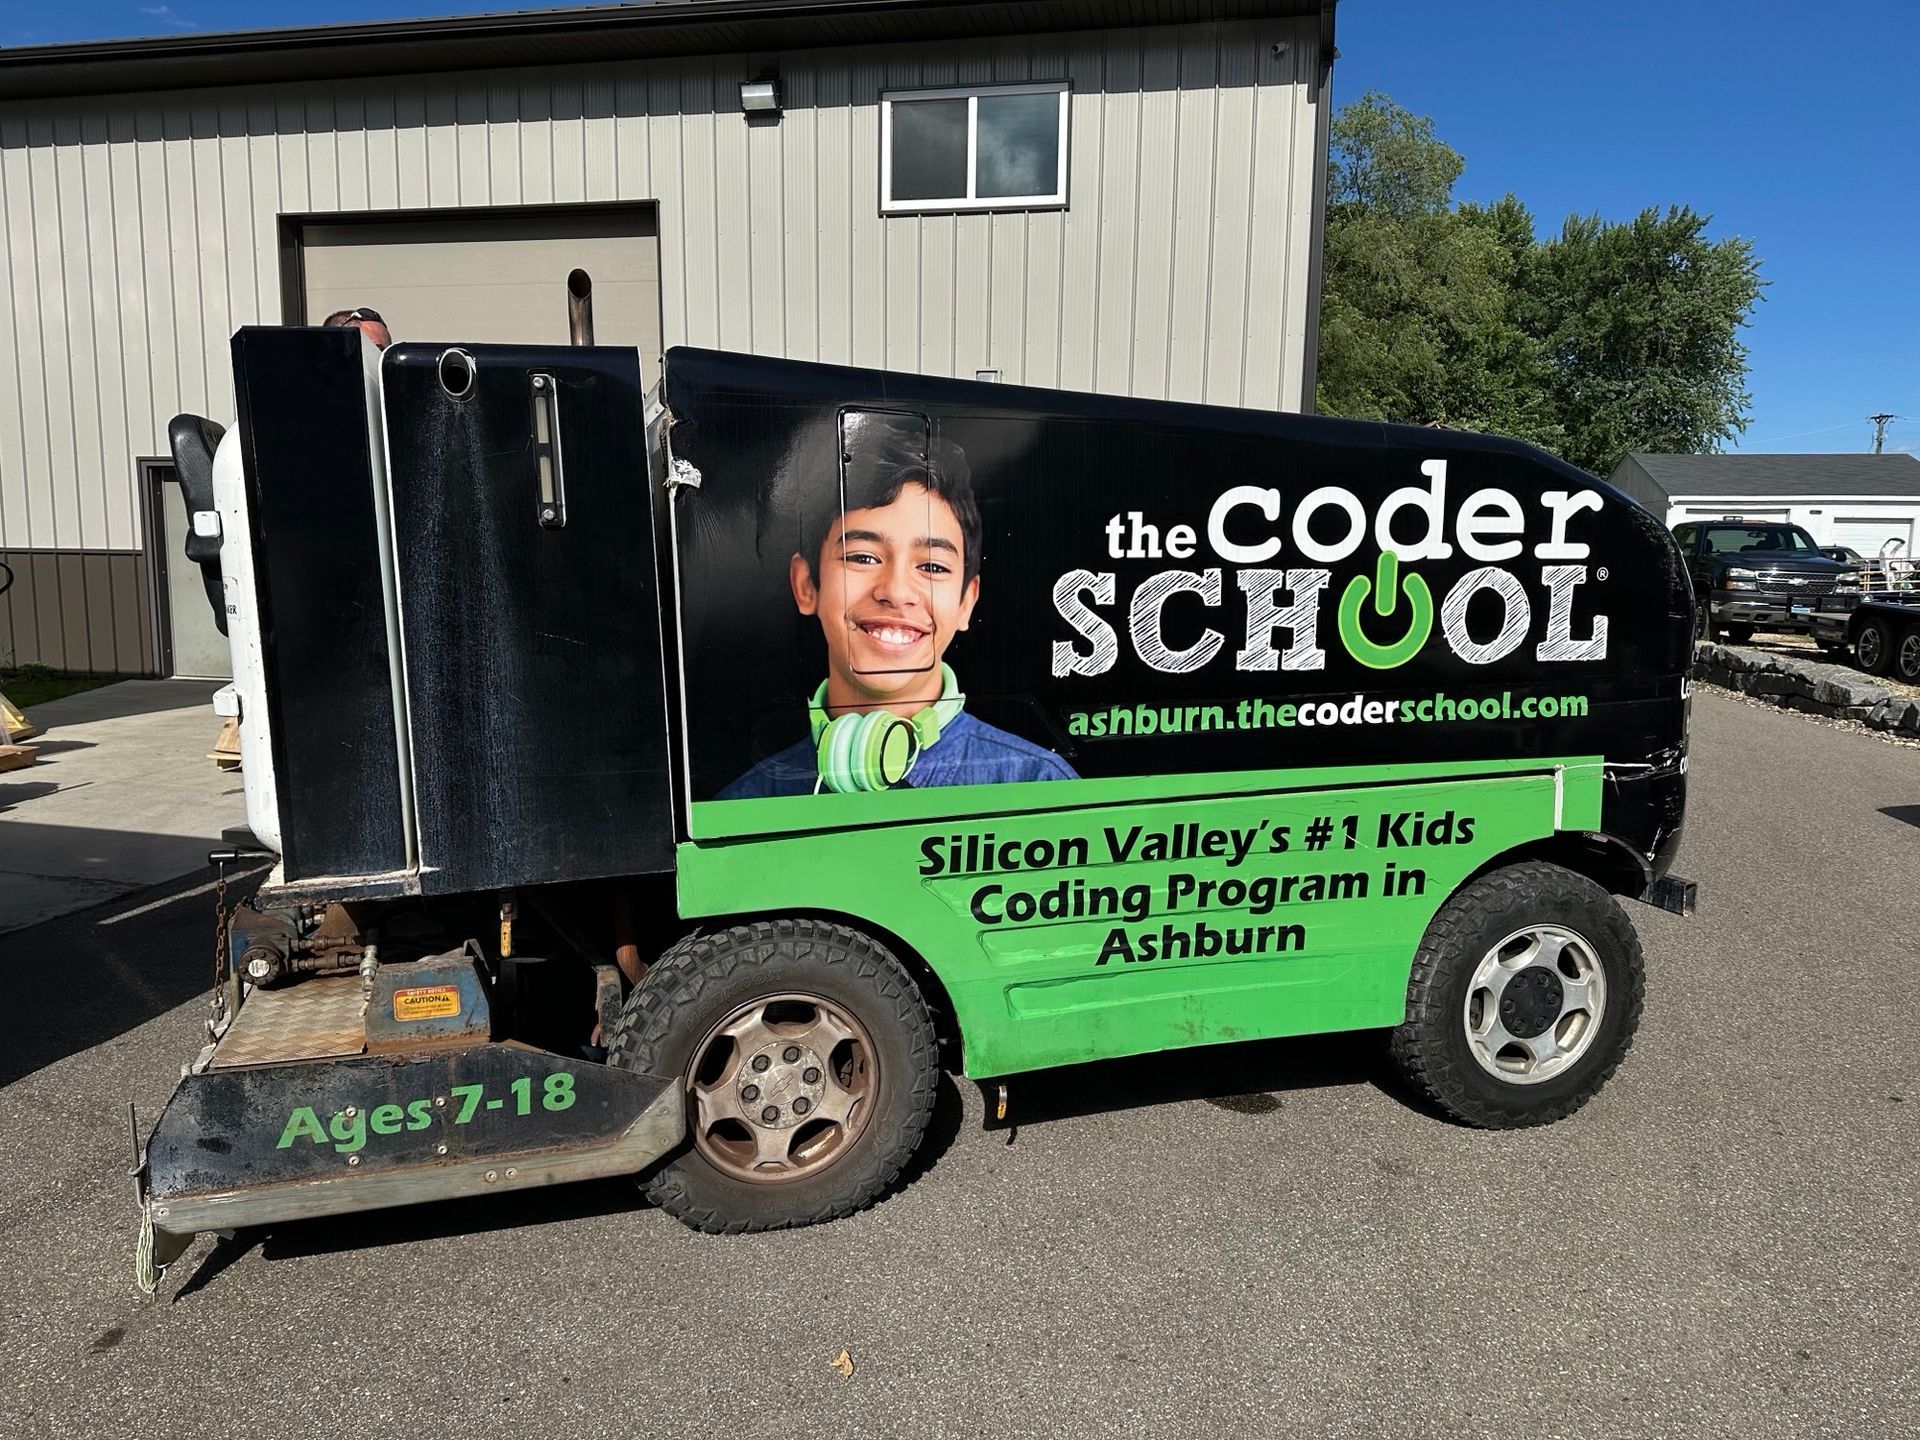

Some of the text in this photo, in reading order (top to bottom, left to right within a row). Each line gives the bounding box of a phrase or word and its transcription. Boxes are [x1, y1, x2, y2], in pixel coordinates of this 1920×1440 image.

[1106, 460, 1603, 563] the coder
[1052, 549, 1608, 678] SCHOOL
[1069, 691, 1589, 736] ashburn.thecoderschool.com
[919, 810, 1475, 876] Silicon Valley's #1 Kids
[970, 862, 1426, 924] Coding Program in
[1095, 922, 1306, 966] Ashburn
[404, 995, 441, 1005] CAUTION
[276, 1072, 576, 1153] Ages 7-18
